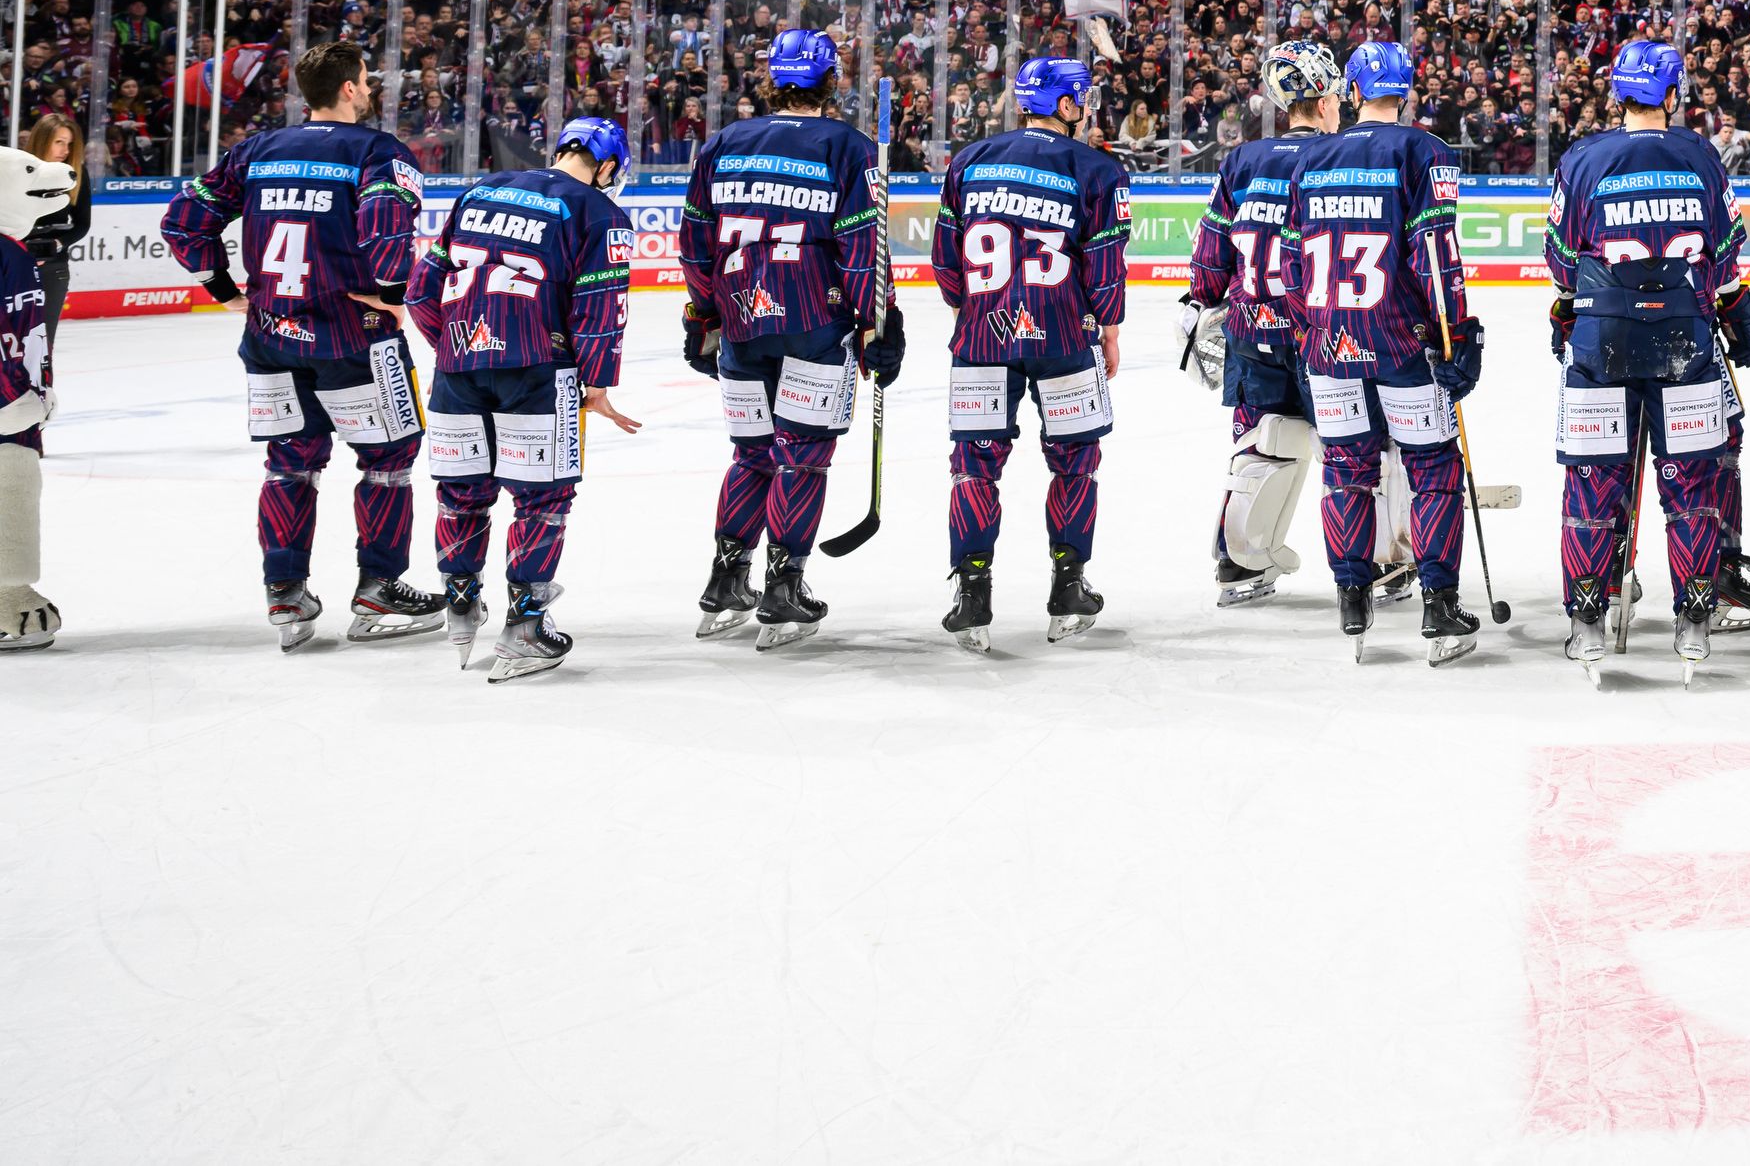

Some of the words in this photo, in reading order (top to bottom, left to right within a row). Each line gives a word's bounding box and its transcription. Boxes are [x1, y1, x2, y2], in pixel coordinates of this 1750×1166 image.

[802, 50, 813, 59] 71
[1612, 74, 1650, 85] STADLER
[719, 158, 772, 170] EISBÄREN
[783, 162, 826, 178] STROM
[974, 167, 1026, 180] EISBÄREN
[1358, 172, 1395, 183] STROM
[1488, 178, 1539, 186] GASAG
[106, 180, 173, 191] GASAG
[260, 188, 333, 213] ELLIS
[711, 181, 838, 213] MELCHIORI
[964, 186, 1076, 229] PFÖDERL
[1309, 196, 1383, 219] REGIN
[1604, 198, 1703, 226] MAUER
[460, 208, 548, 245] CLARK
[719, 214, 806, 275] 71
[261, 222, 310, 298] 4
[963, 220, 1073, 297] 93
[1302, 230, 1390, 310] 13
[384, 346, 416, 429] CONTIPARK
[785, 375, 834, 389] SPORTMETROPOLE
[781, 389, 811, 403] BERLIN
[1046, 387, 1093, 401] SPORTMETROPOLE
[1048, 406, 1080, 417] BERLIN
[1670, 402, 1718, 412] SPORTMETROPOLE
[565, 375, 579, 470] CONTIPARK
[1570, 424, 1600, 432] BERLIN
[1671, 420, 1704, 430] BERLIN
[433, 446, 458, 455] BERLIN
[500, 447, 525, 458] BERLIN
